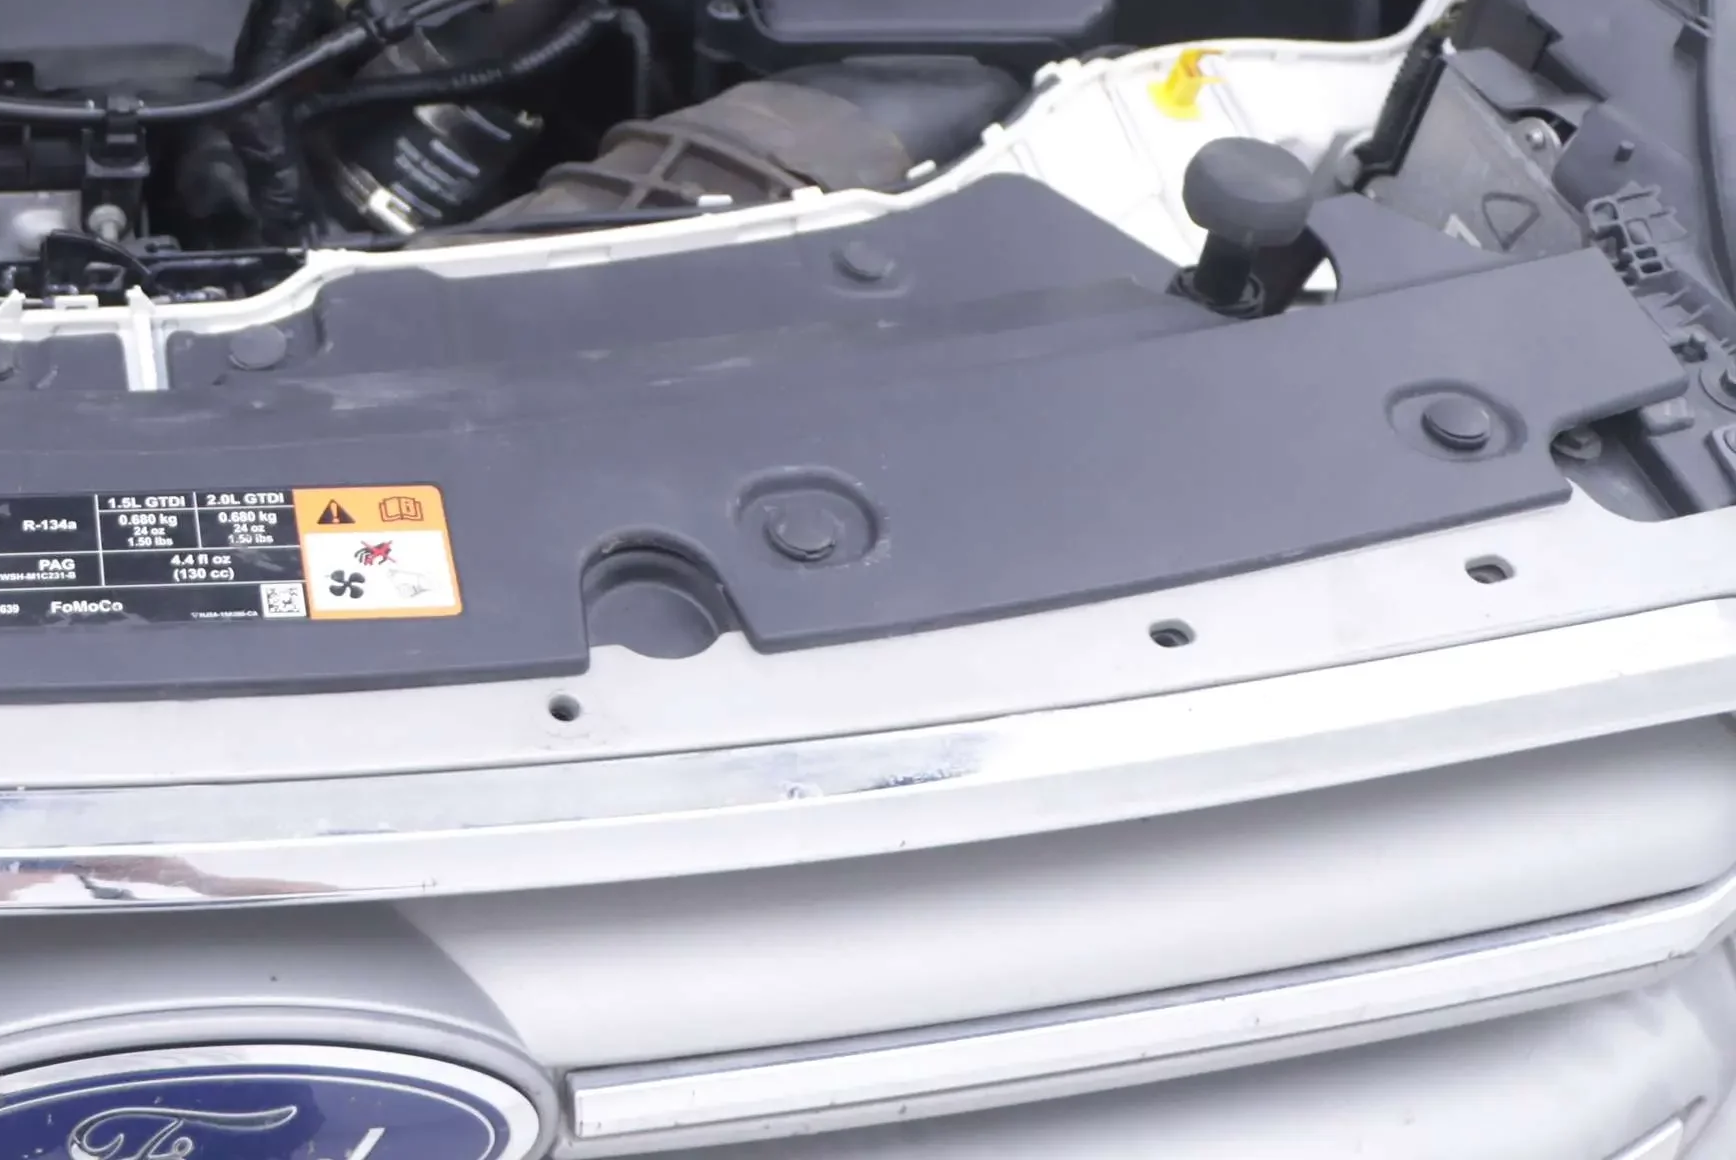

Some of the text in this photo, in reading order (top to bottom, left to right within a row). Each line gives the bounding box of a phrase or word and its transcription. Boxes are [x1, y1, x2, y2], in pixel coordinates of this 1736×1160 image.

[107, 496, 186, 509] 1.5L GTDI
[206, 492, 285, 506] 2.0L GTDI
[118, 513, 178, 528] 0.680 kg
[218, 511, 278, 525] 0.680 kg
[22, 519, 77, 531] R-134a
[133, 526, 166, 536] 24 oz
[233, 524, 265, 534] 24 oz
[127, 537, 152, 547] 1.50
[38, 558, 76, 571] PAG
[170, 554, 195, 566] 4.4
[212, 555, 232, 565] oz
[173, 567, 235, 582] (130 cc)
[50, 600, 124, 614] FoMoCo
